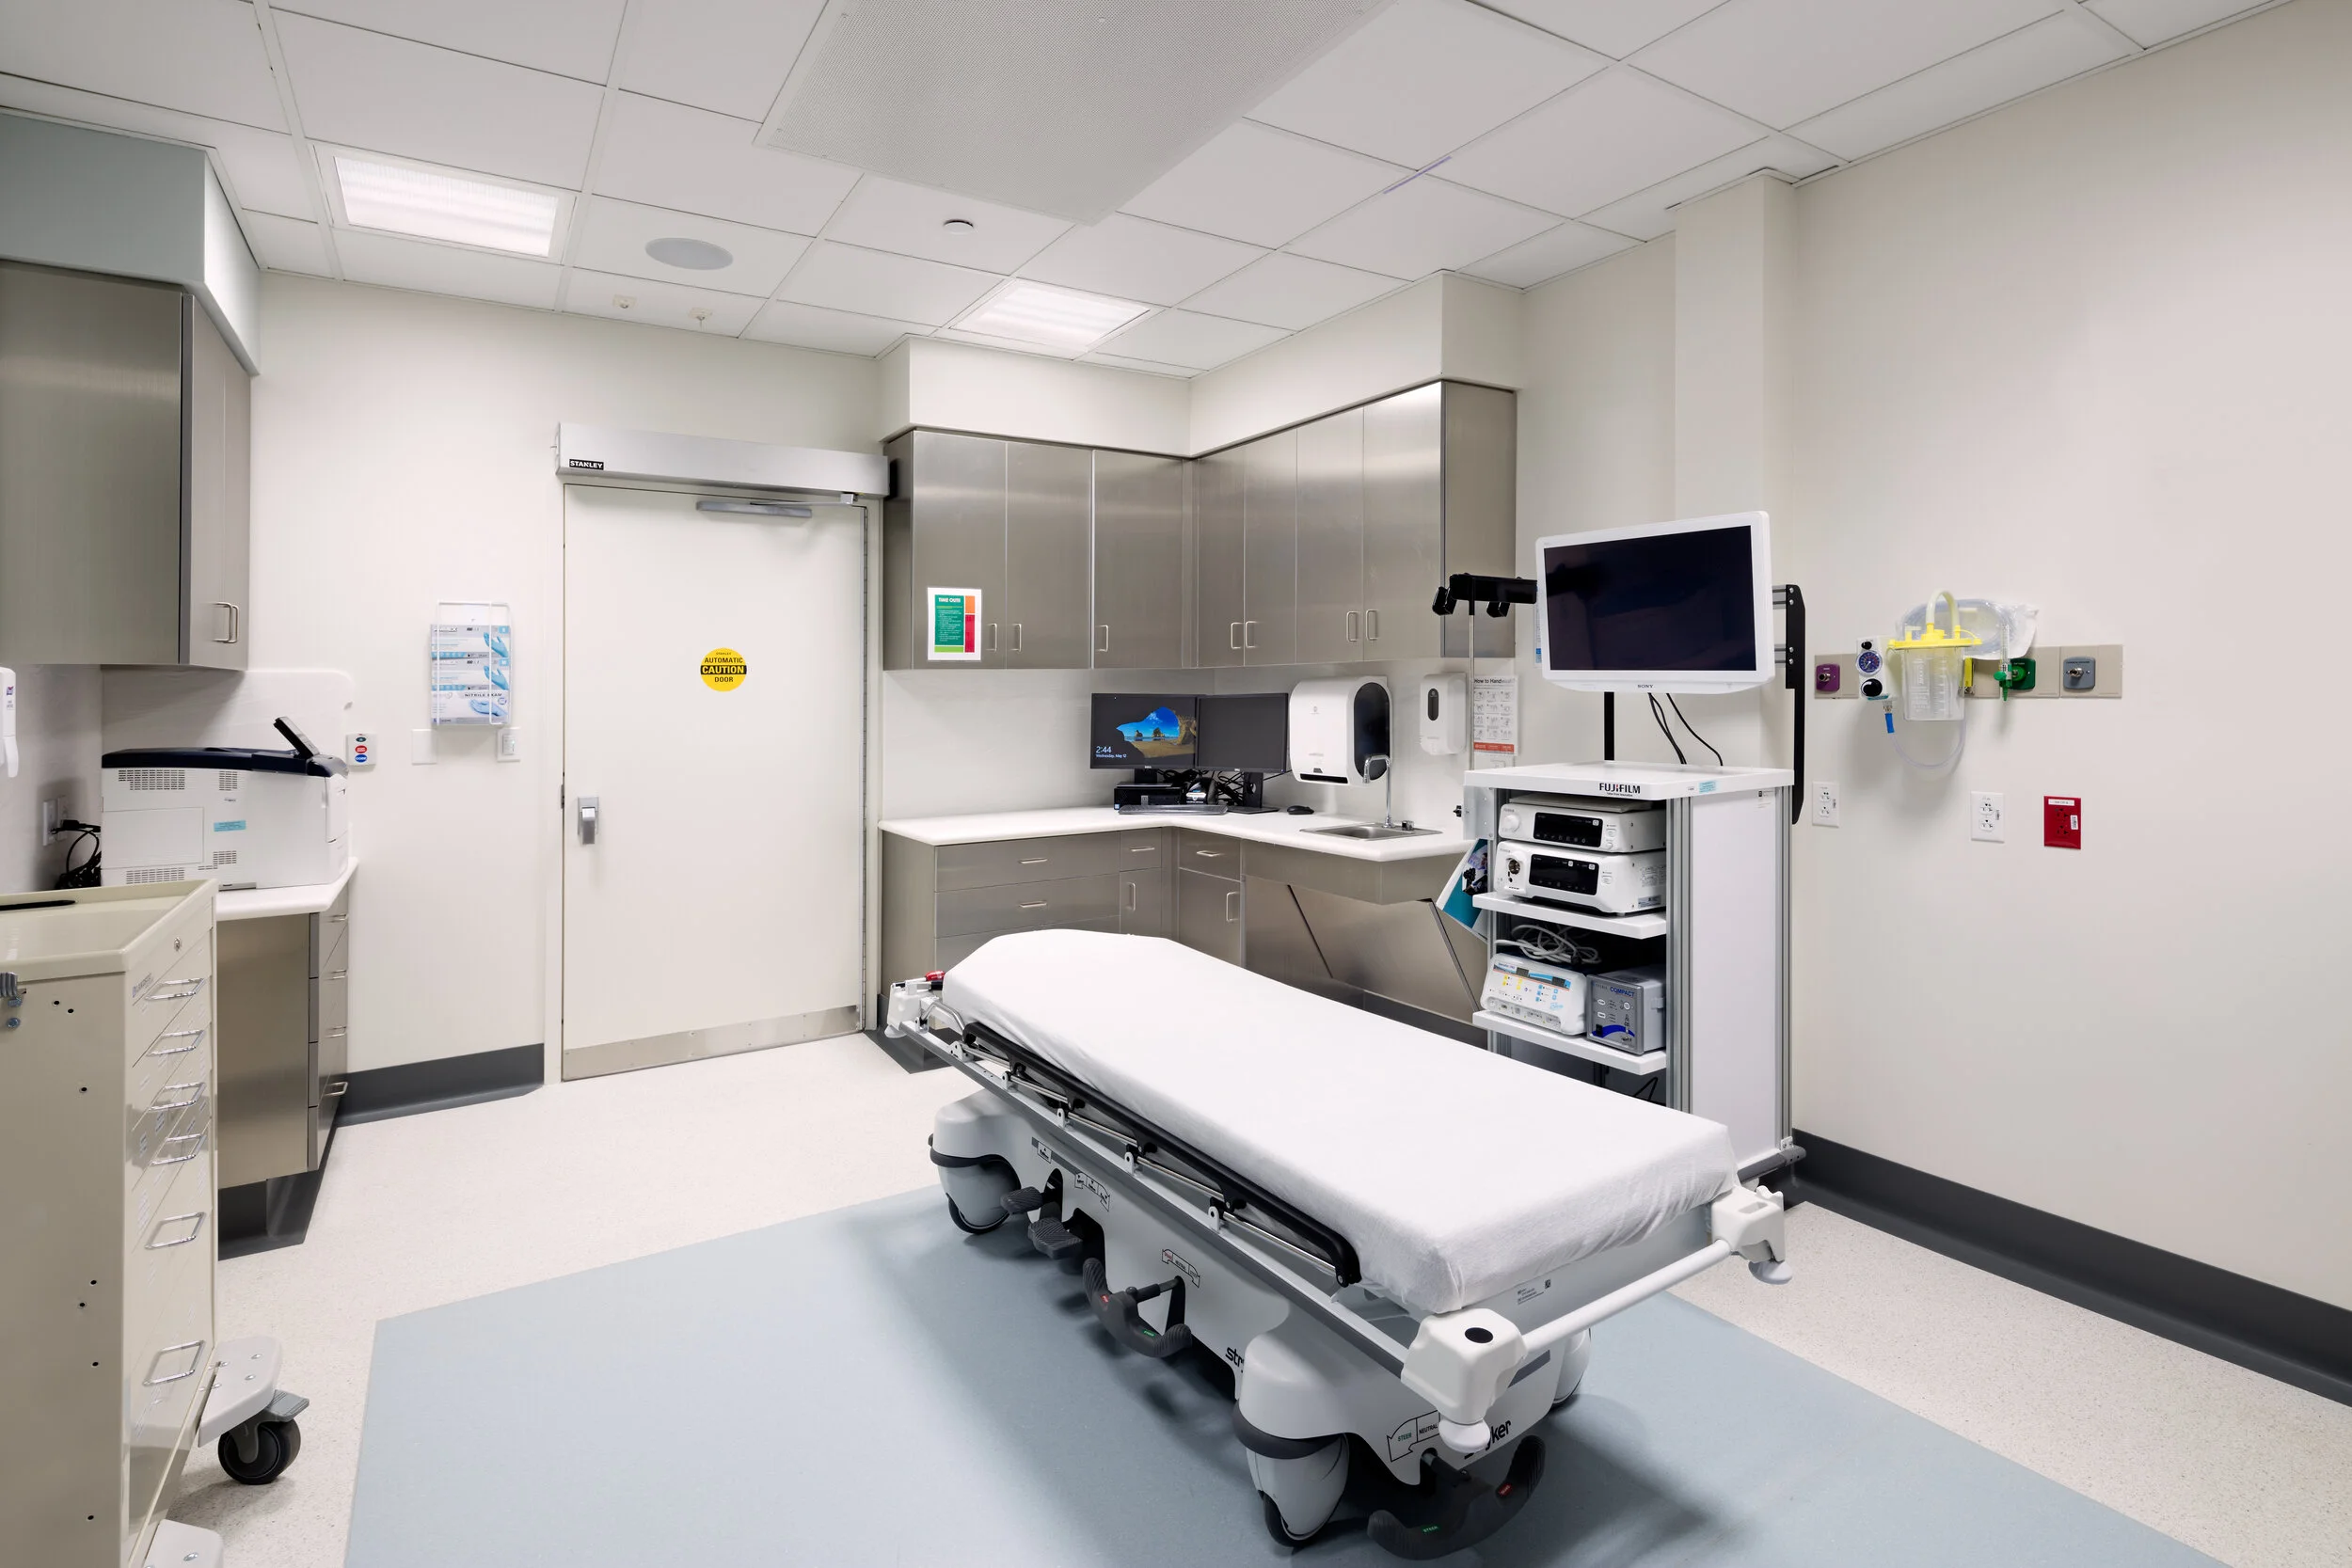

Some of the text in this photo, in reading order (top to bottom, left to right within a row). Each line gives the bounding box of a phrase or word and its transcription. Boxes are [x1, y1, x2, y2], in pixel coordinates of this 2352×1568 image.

[570, 460, 603, 468] STANLEY
[702, 665, 744, 674] CAUTION
[1599, 783, 1641, 794] FUJIFILM
[1610, 986, 1635, 997] COMPACT
[1397, 1422, 1438, 1442] STEER NEUTRAL
